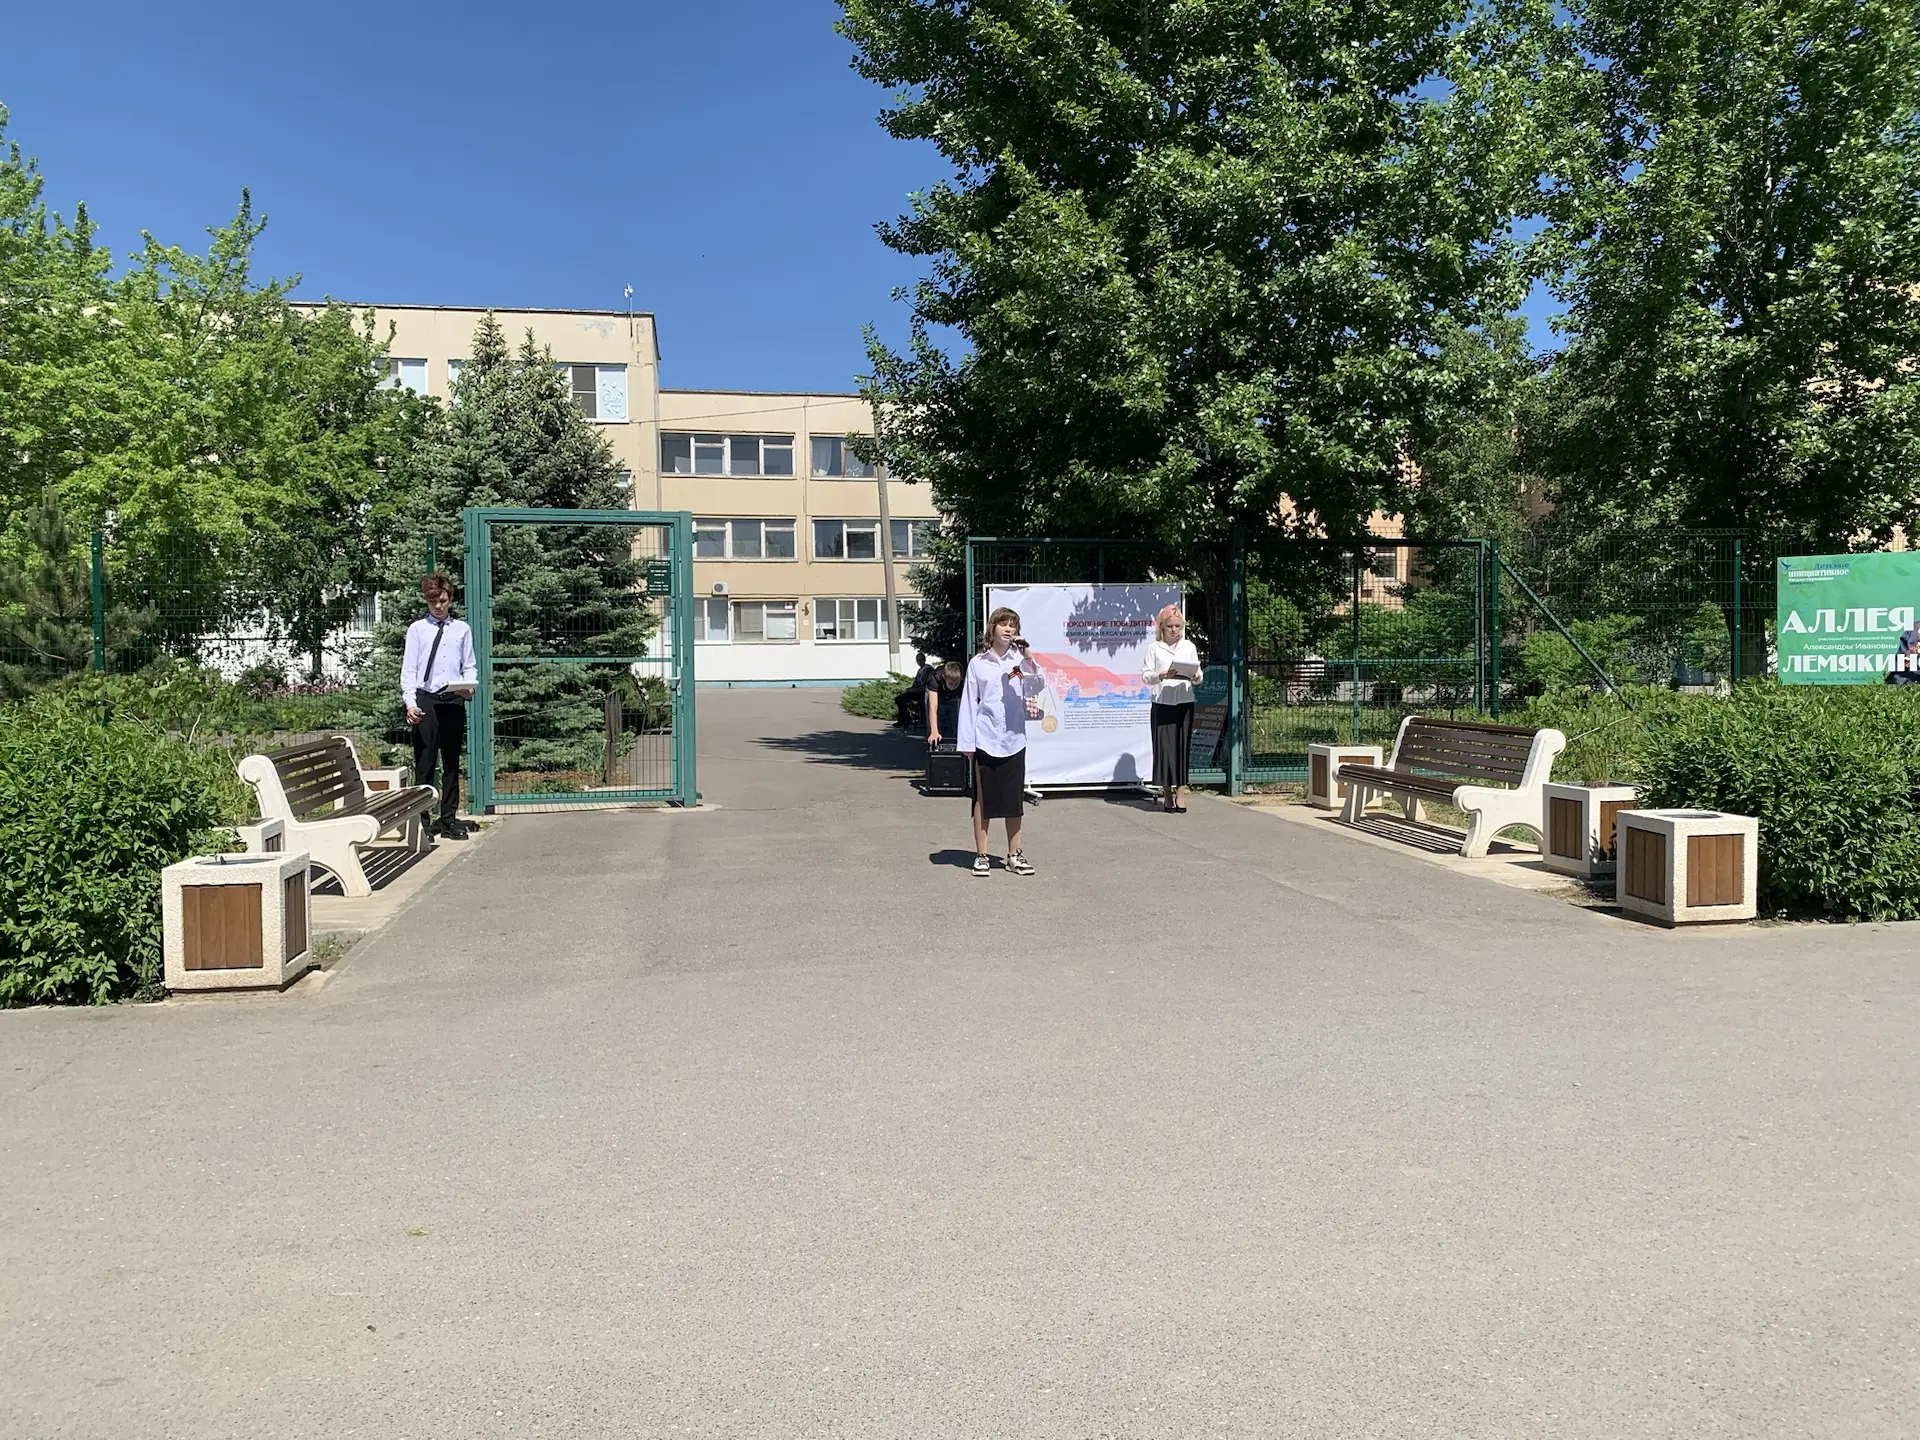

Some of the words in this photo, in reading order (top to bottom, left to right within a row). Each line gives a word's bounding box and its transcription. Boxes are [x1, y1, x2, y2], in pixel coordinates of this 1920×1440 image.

[1788, 569, 1849, 578] инициативное
[1781, 606, 1915, 633] АЛЛЕЯ
[1803, 643, 1853, 651] Александры
[1855, 642, 1898, 650] Ивановны
[1782, 653, 1920, 673] ЛЕМЯКИН
